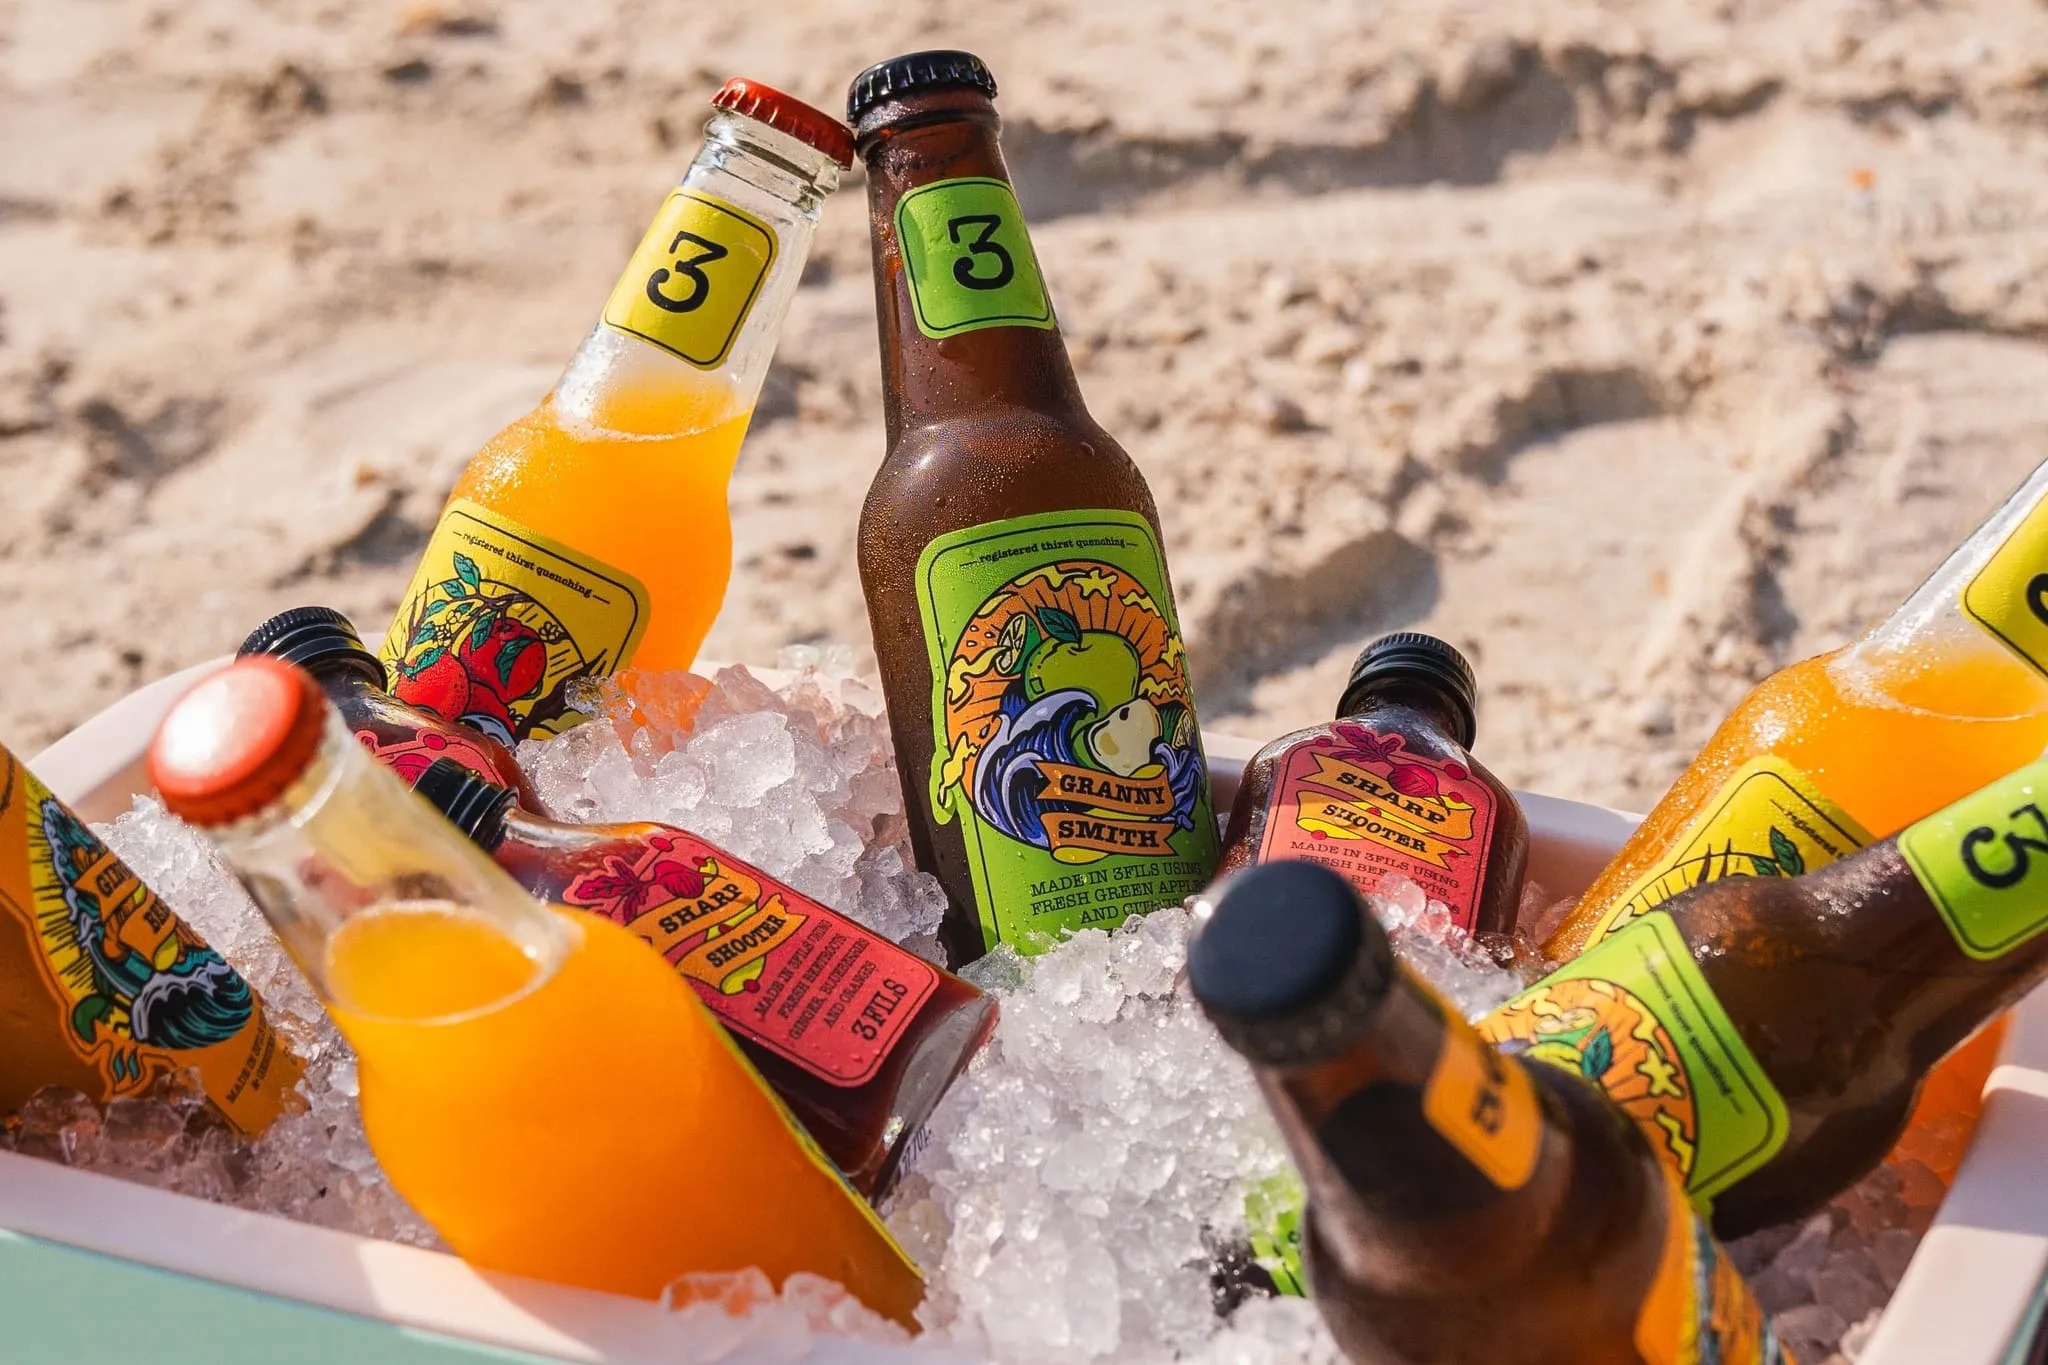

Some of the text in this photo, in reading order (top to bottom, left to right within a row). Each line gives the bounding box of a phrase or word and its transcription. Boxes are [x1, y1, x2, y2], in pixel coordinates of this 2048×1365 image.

[646, 230, 729, 313] 3
[948, 214, 1015, 290] 3
[462, 533, 593, 598] registered thirst quenching
[980, 537, 1126, 562] registered thirst quenching
[1060, 774, 1165, 805] GRANNY
[1336, 771, 1446, 824] SHARP
[1058, 820, 1159, 848] SMITH
[1322, 804, 1428, 853] SHOOTER
[1961, 803, 2048, 889] 3
[1030, 861, 1201, 897] MADE IN 3FILS USING
[1291, 841, 1459, 888] MADE IN 3FILS USING
[659, 883, 742, 934] SHARP
[1030, 892, 1091, 916] FRESH
[1094, 882, 1154, 902] GREEN
[1080, 905, 1119, 924] AND
[706, 914, 787, 968] SHOOTER
[754, 981, 785, 1015] MADE
[777, 967, 794, 983] IN
[777, 981, 810, 1019] FRESH
[824, 960, 877, 1028] AND ORANGES
[851, 978, 908, 1041] 3FILS
